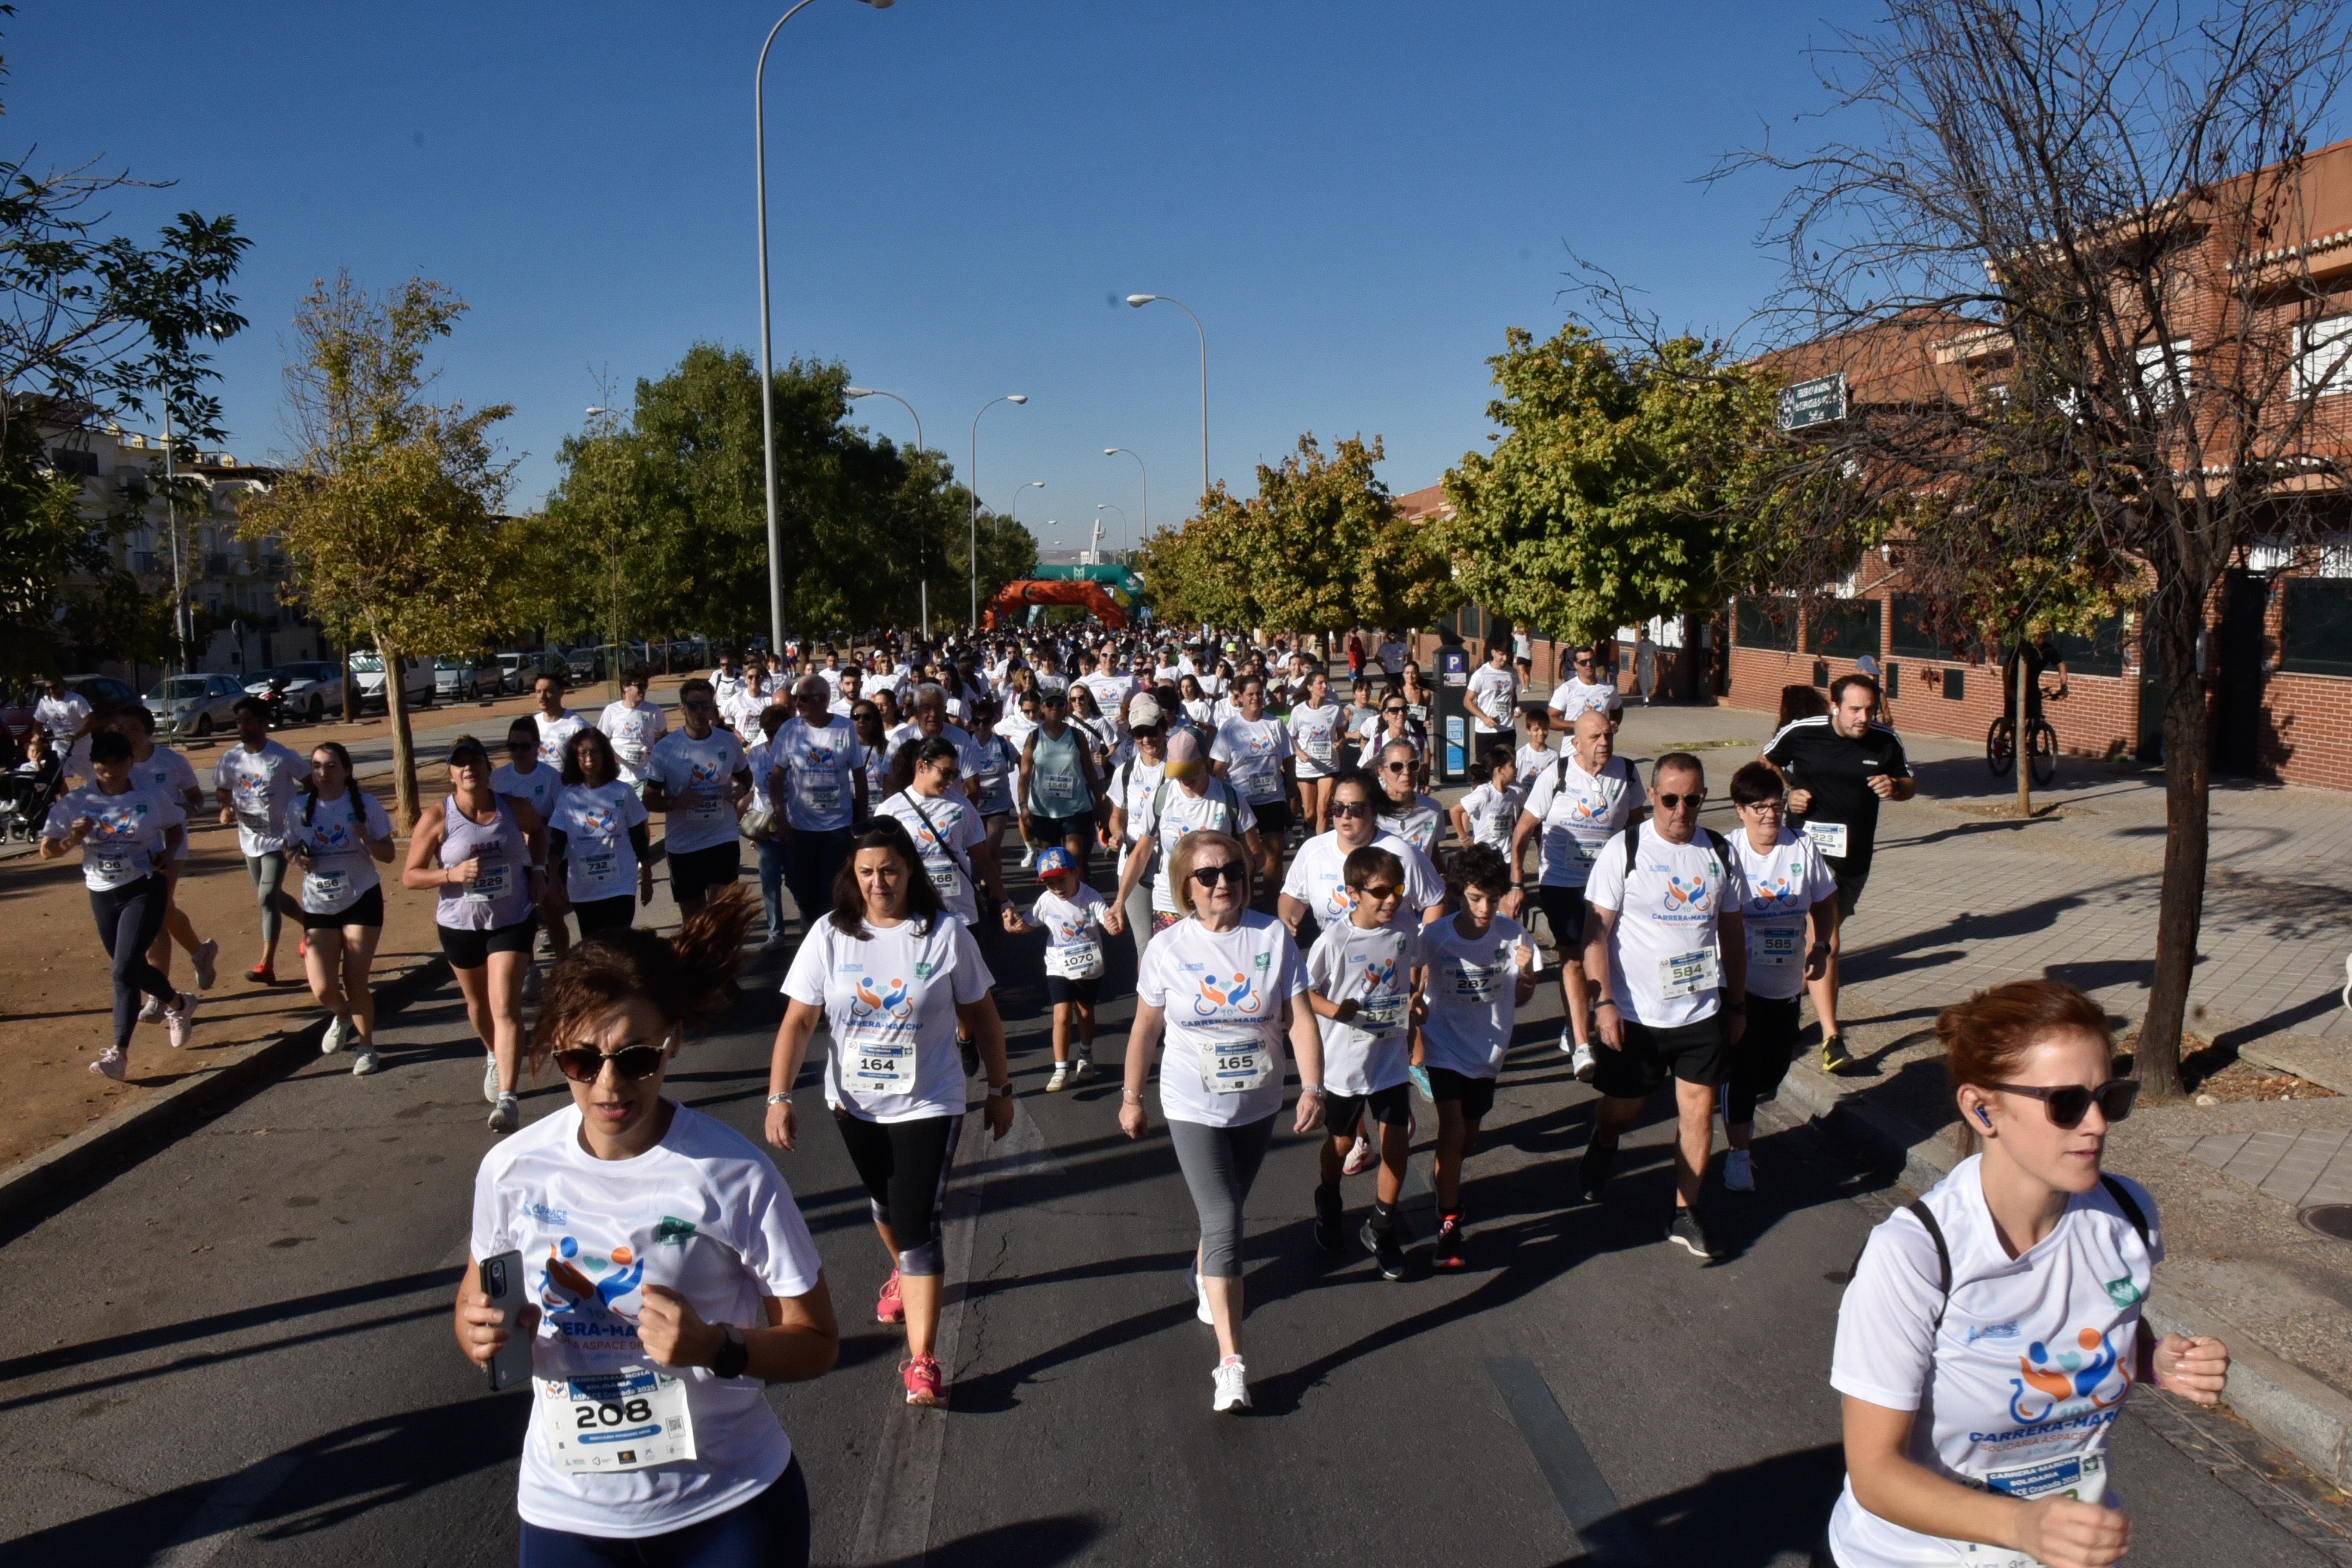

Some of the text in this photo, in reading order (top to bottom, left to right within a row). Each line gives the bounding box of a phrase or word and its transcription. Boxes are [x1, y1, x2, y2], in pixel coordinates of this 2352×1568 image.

[1450, 656, 1459, 670] P
[98, 860, 121, 869] 906
[587, 861, 608, 871] 732
[316, 878, 339, 889] 856
[1765, 939, 1792, 949] 585
[1064, 953, 1094, 967] 1070
[1673, 963, 1702, 979] 584
[1457, 978, 1490, 989] 287
[1181, 1015, 1275, 1027] CARRERA-MARCHA
[1366, 1010, 1394, 1022] 871
[861, 1058, 895, 1071] 164
[1218, 1055, 1254, 1070] 165
[586, 1380, 633, 1391] SOLIDARIA
[572, 1384, 656, 1401] ASPACE Granada 2025
[575, 1398, 653, 1429] 208
[1980, 1438, 2039, 1453] SOLIDARIA
[1989, 1458, 2077, 1480] CARRERA-MARCHA
[2010, 1471, 2059, 1487] SOLIDARIA
